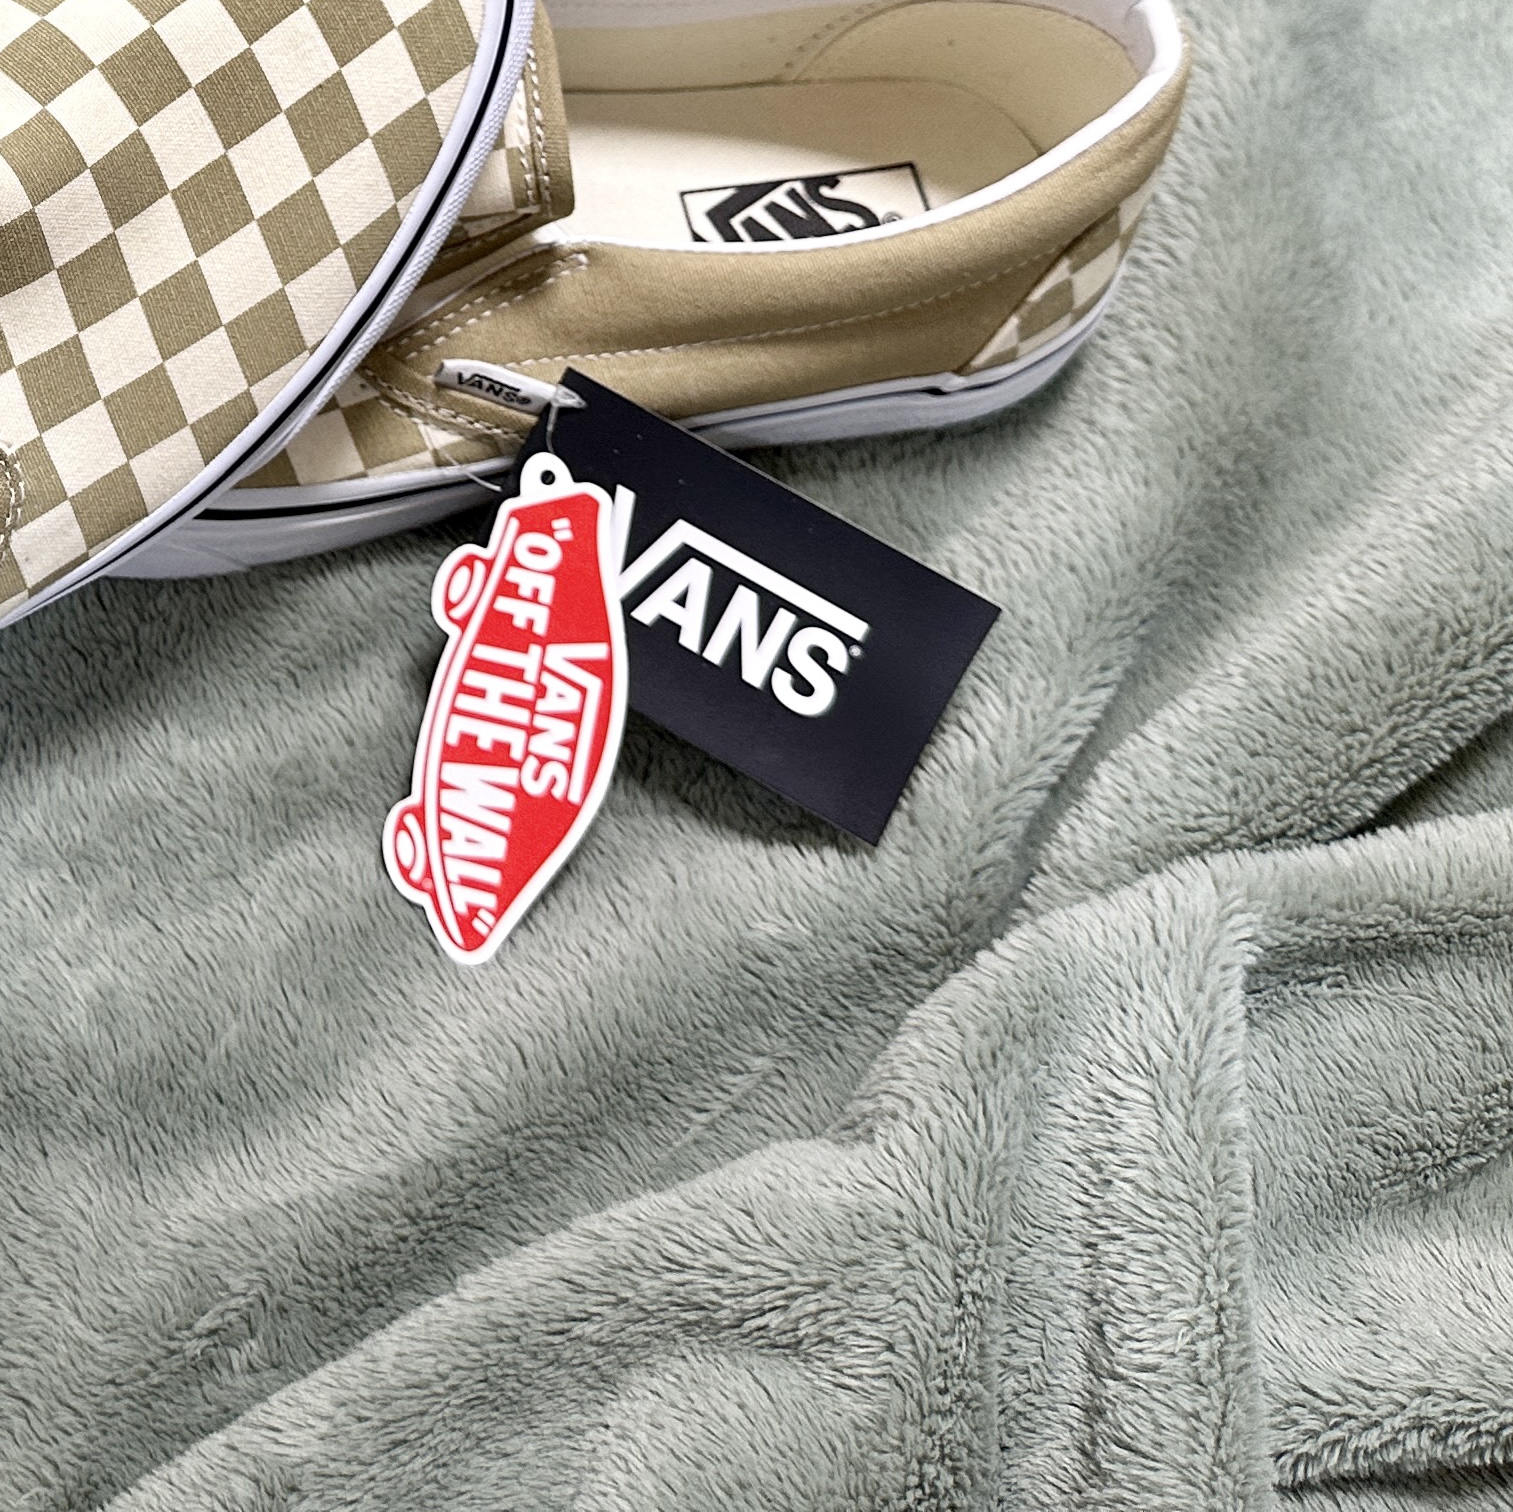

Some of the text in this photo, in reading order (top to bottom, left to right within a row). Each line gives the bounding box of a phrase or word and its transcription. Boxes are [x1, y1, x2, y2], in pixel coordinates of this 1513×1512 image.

[437, 518, 572, 935] "OFF THE WALL"
[521, 641, 609, 805] VANS
